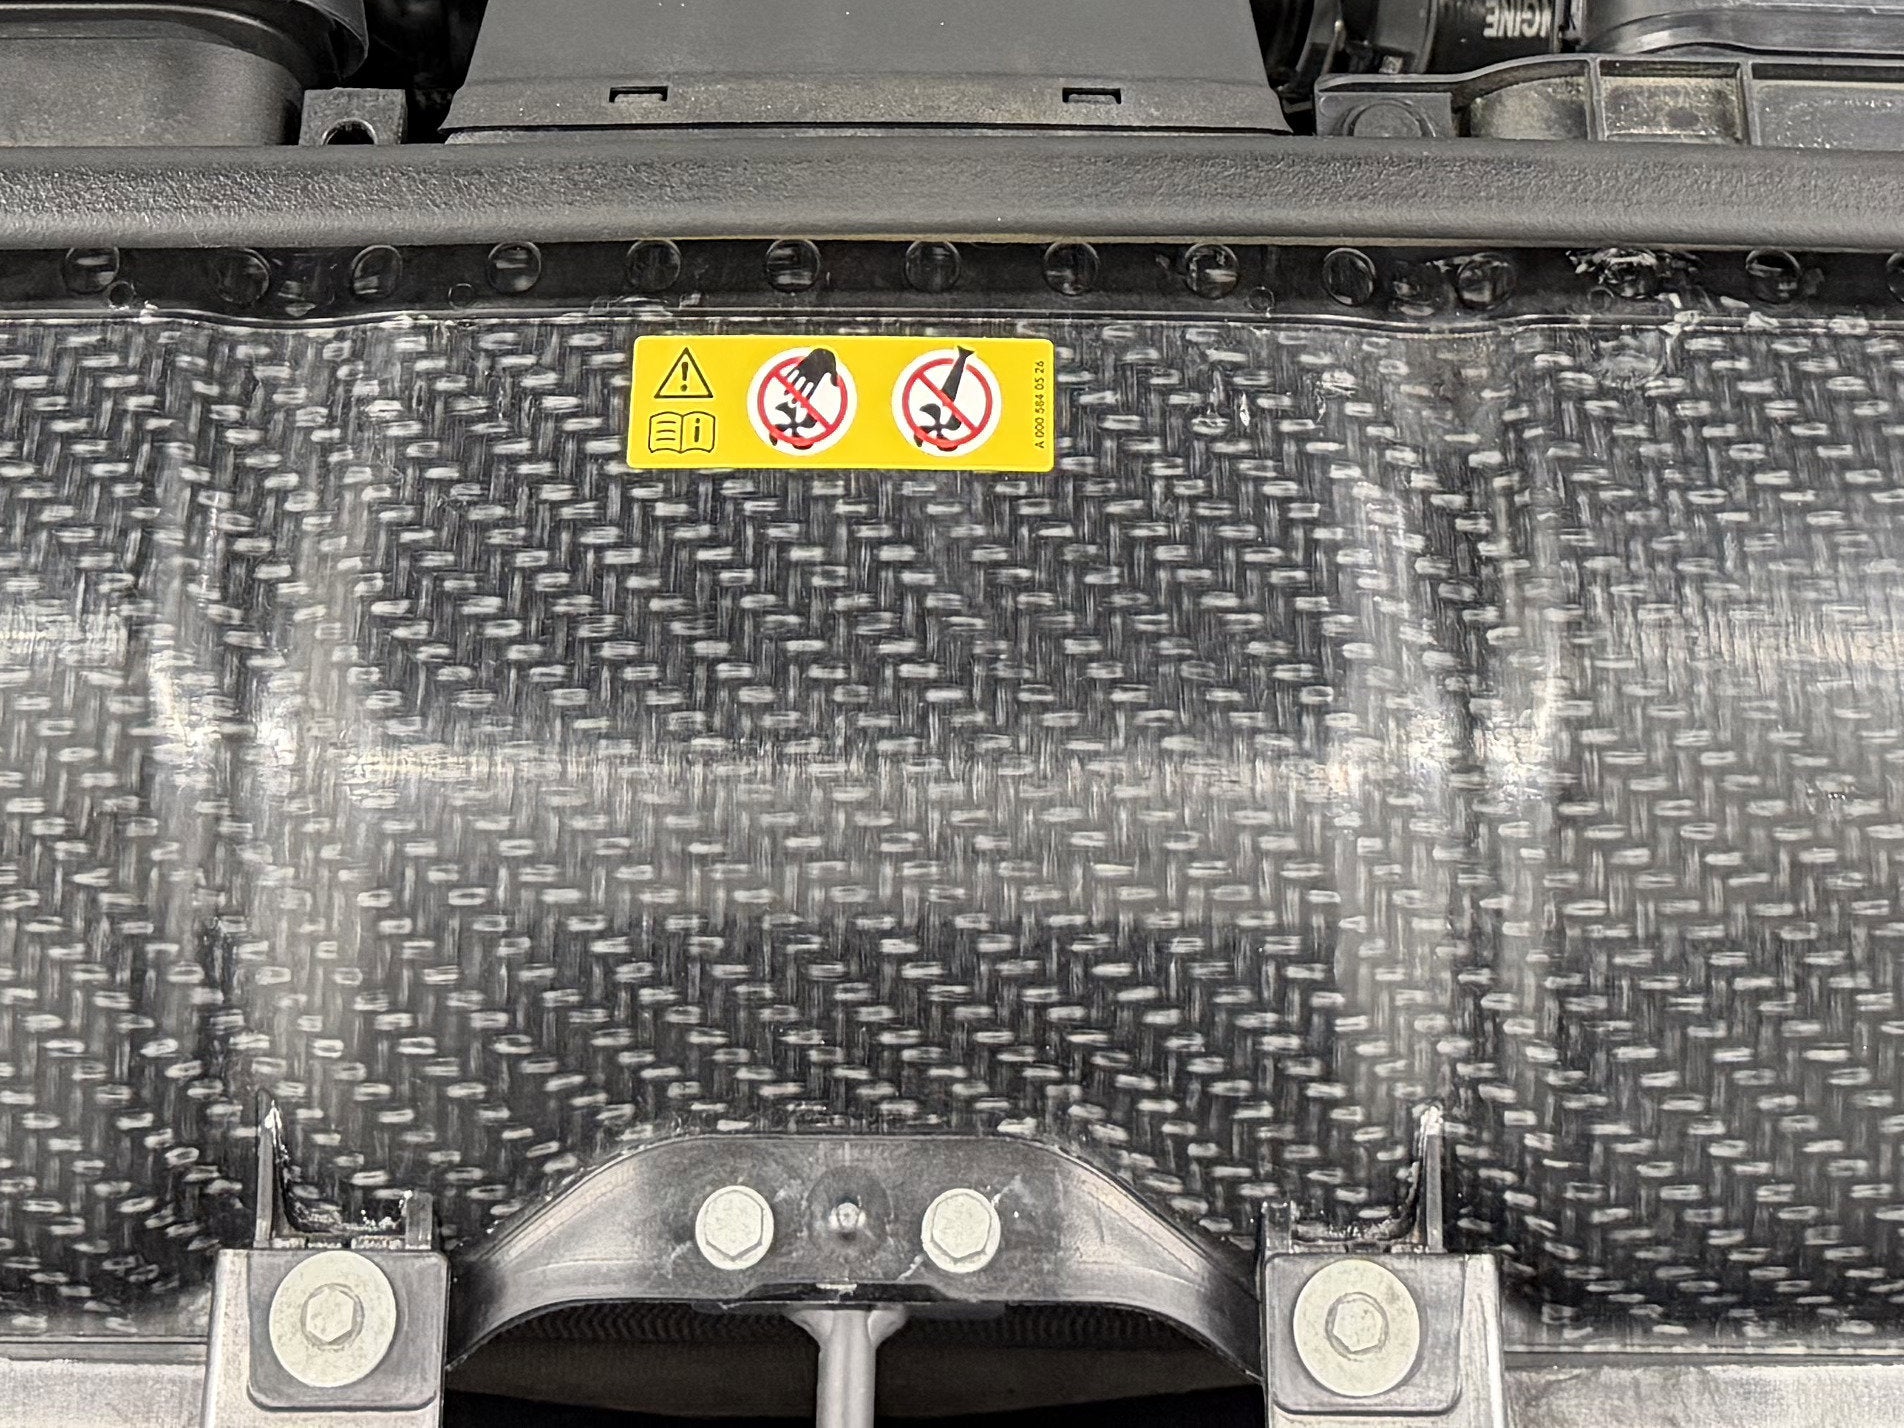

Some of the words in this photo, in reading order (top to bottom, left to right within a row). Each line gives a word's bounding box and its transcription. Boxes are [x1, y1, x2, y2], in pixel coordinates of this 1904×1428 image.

[1035, 361, 1044, 373] 26
[1035, 377, 1044, 390] 05
[1035, 418, 1044, 437] 000
